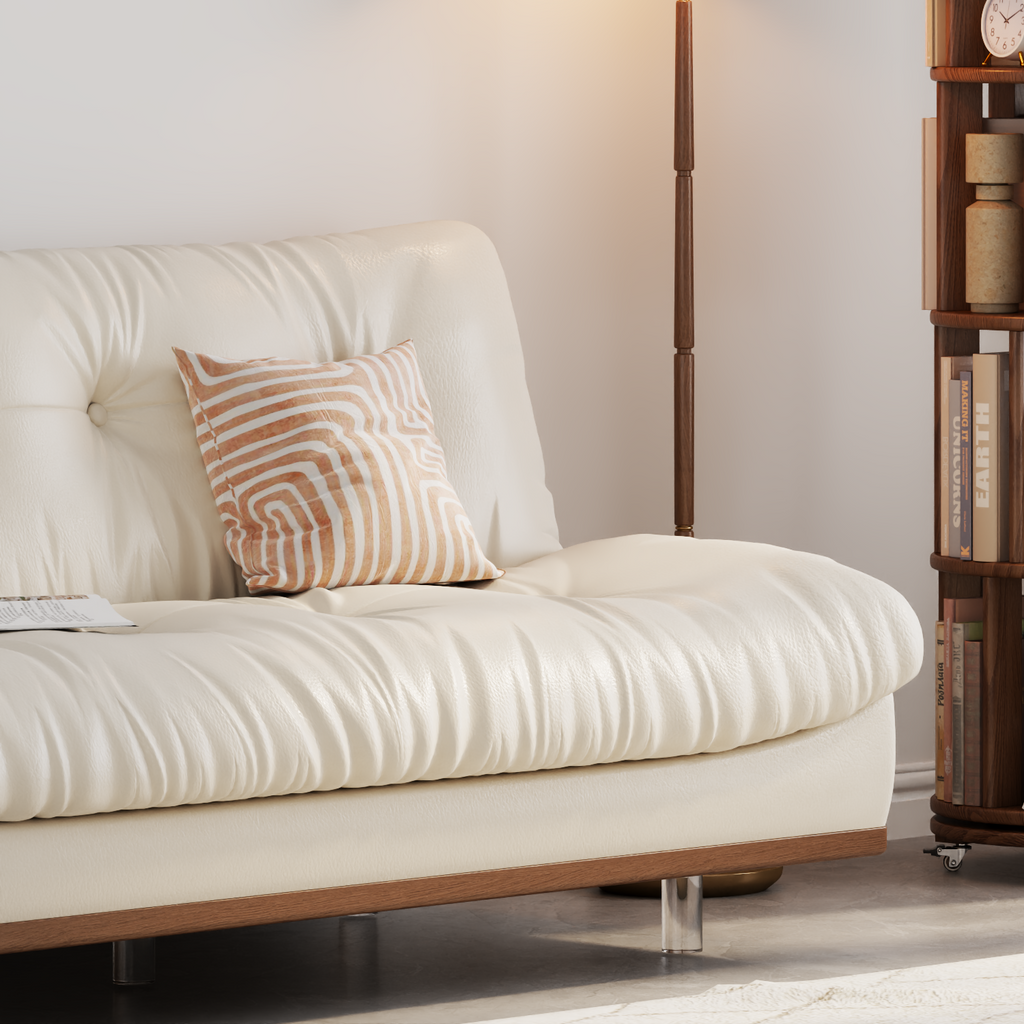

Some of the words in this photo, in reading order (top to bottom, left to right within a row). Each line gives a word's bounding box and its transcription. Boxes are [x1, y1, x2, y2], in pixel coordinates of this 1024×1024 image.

[993, 3, 999, 12] 10
[989, 15, 994, 24] 9
[1021, 16, 1024, 25] 3
[990, 27, 995, 37] 8
[1017, 29, 1022, 37] 4
[995, 36, 1000, 45] 7
[1011, 37, 1015, 46] 5
[1002, 41, 1007, 50] 6
[961, 380, 969, 427] MAKING
[961, 429, 969, 442] IT
[975, 402, 990, 508] EARTH
[952, 416, 961, 528] UNICORNS
